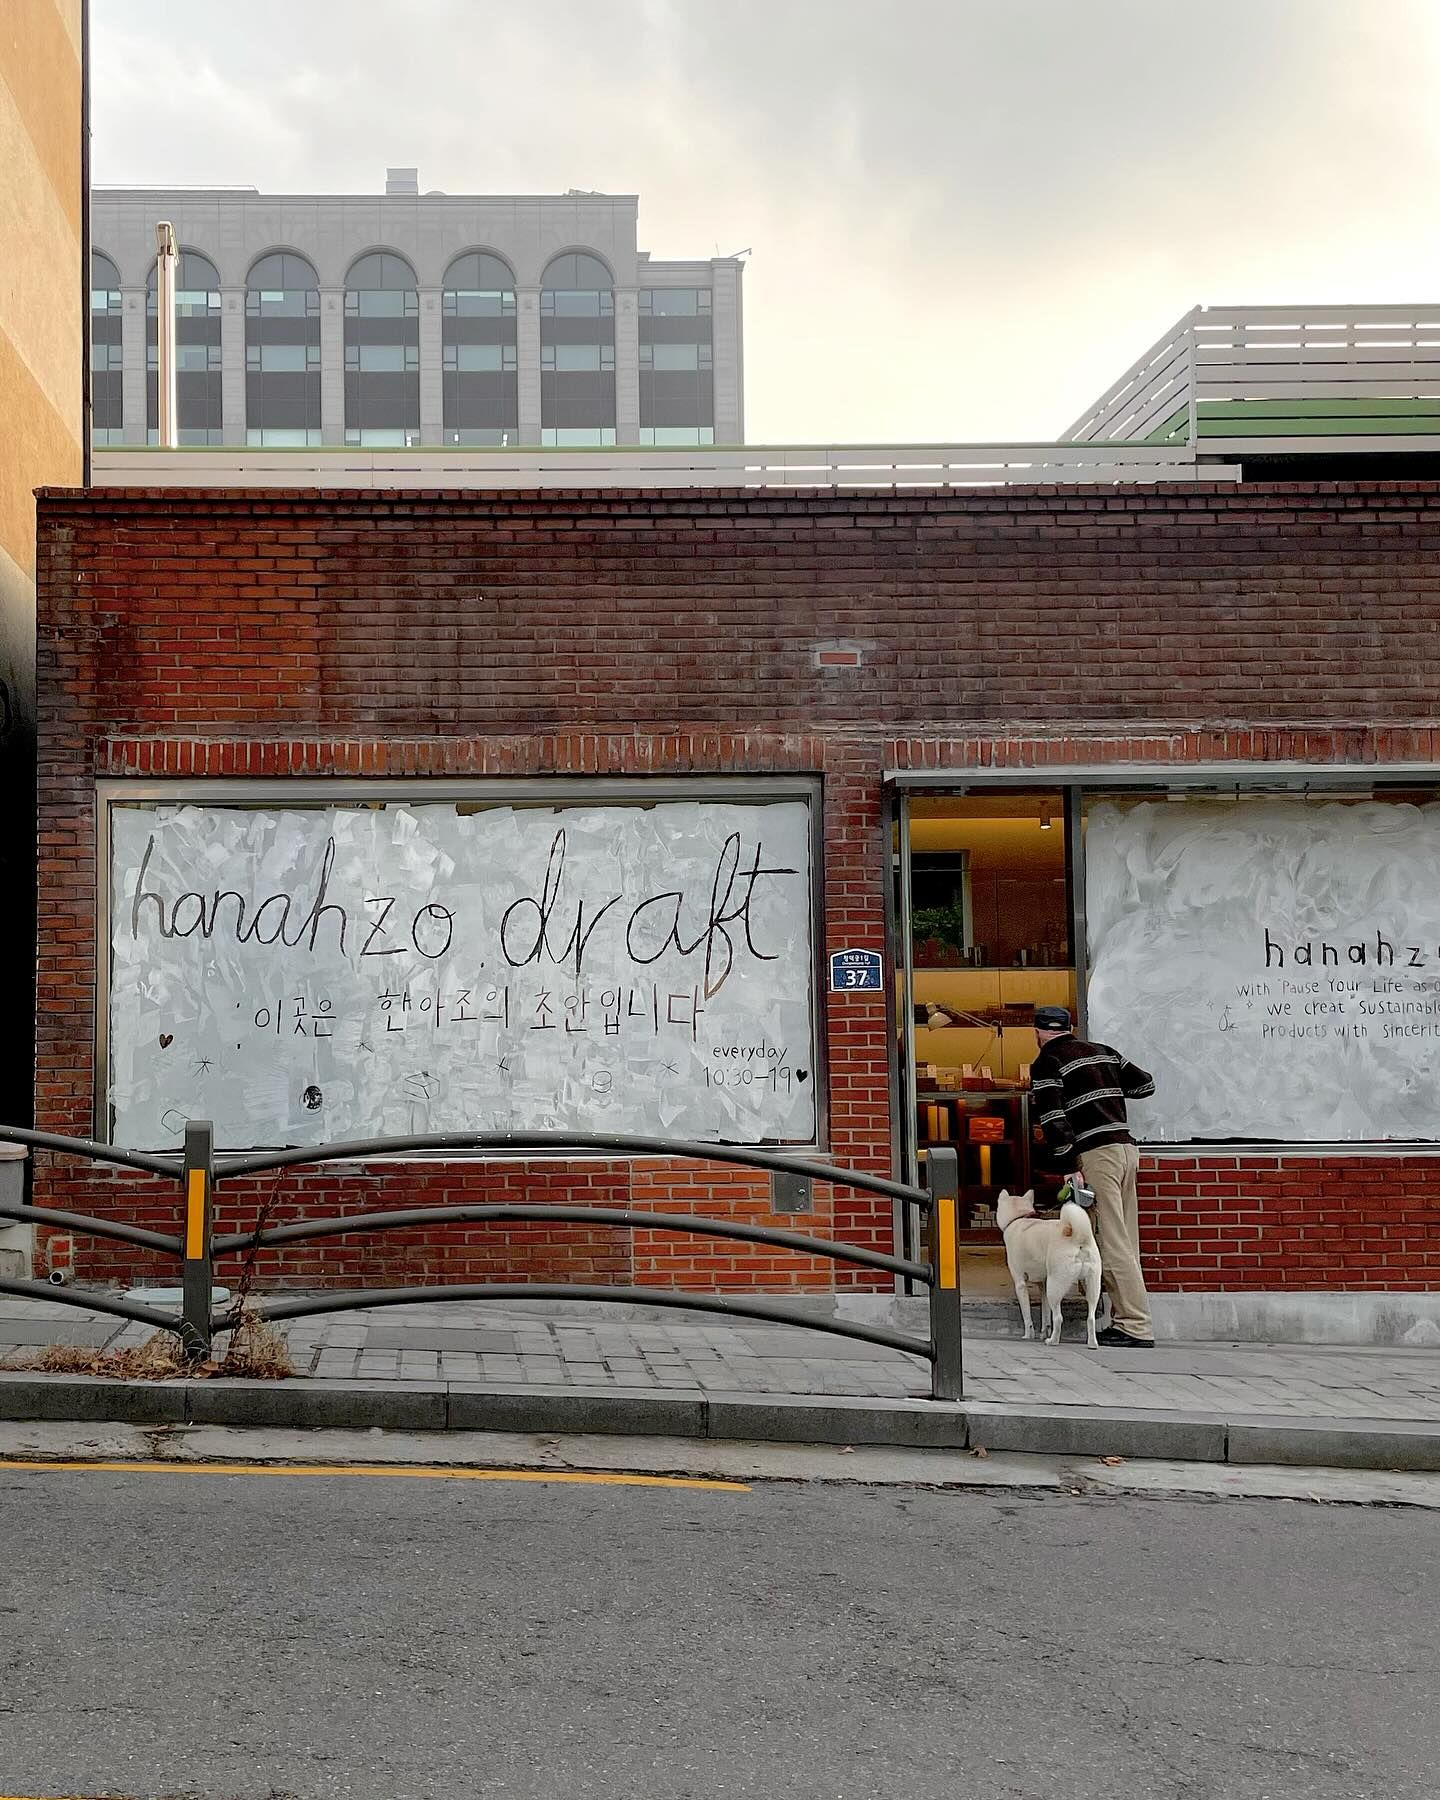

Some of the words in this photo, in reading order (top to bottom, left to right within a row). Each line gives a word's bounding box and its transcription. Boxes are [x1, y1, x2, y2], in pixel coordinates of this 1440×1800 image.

[131, 834, 457, 959] hanahzo
[500, 828, 799, 1000] draft
[1264, 927, 1440, 968] hanahz
[845, 969, 868, 986] 37
[1327, 977, 1362, 993] Your
[1412, 981, 1428, 993] as
[254, 997, 336, 1037] 이곳은
[377, 986, 509, 1032] 한아조의
[529, 984, 704, 1042] 초안입니다
[1304, 1000, 1346, 1016] creat
[1334, 1023, 1368, 1039] with
[712, 1038, 788, 1066] everyday
